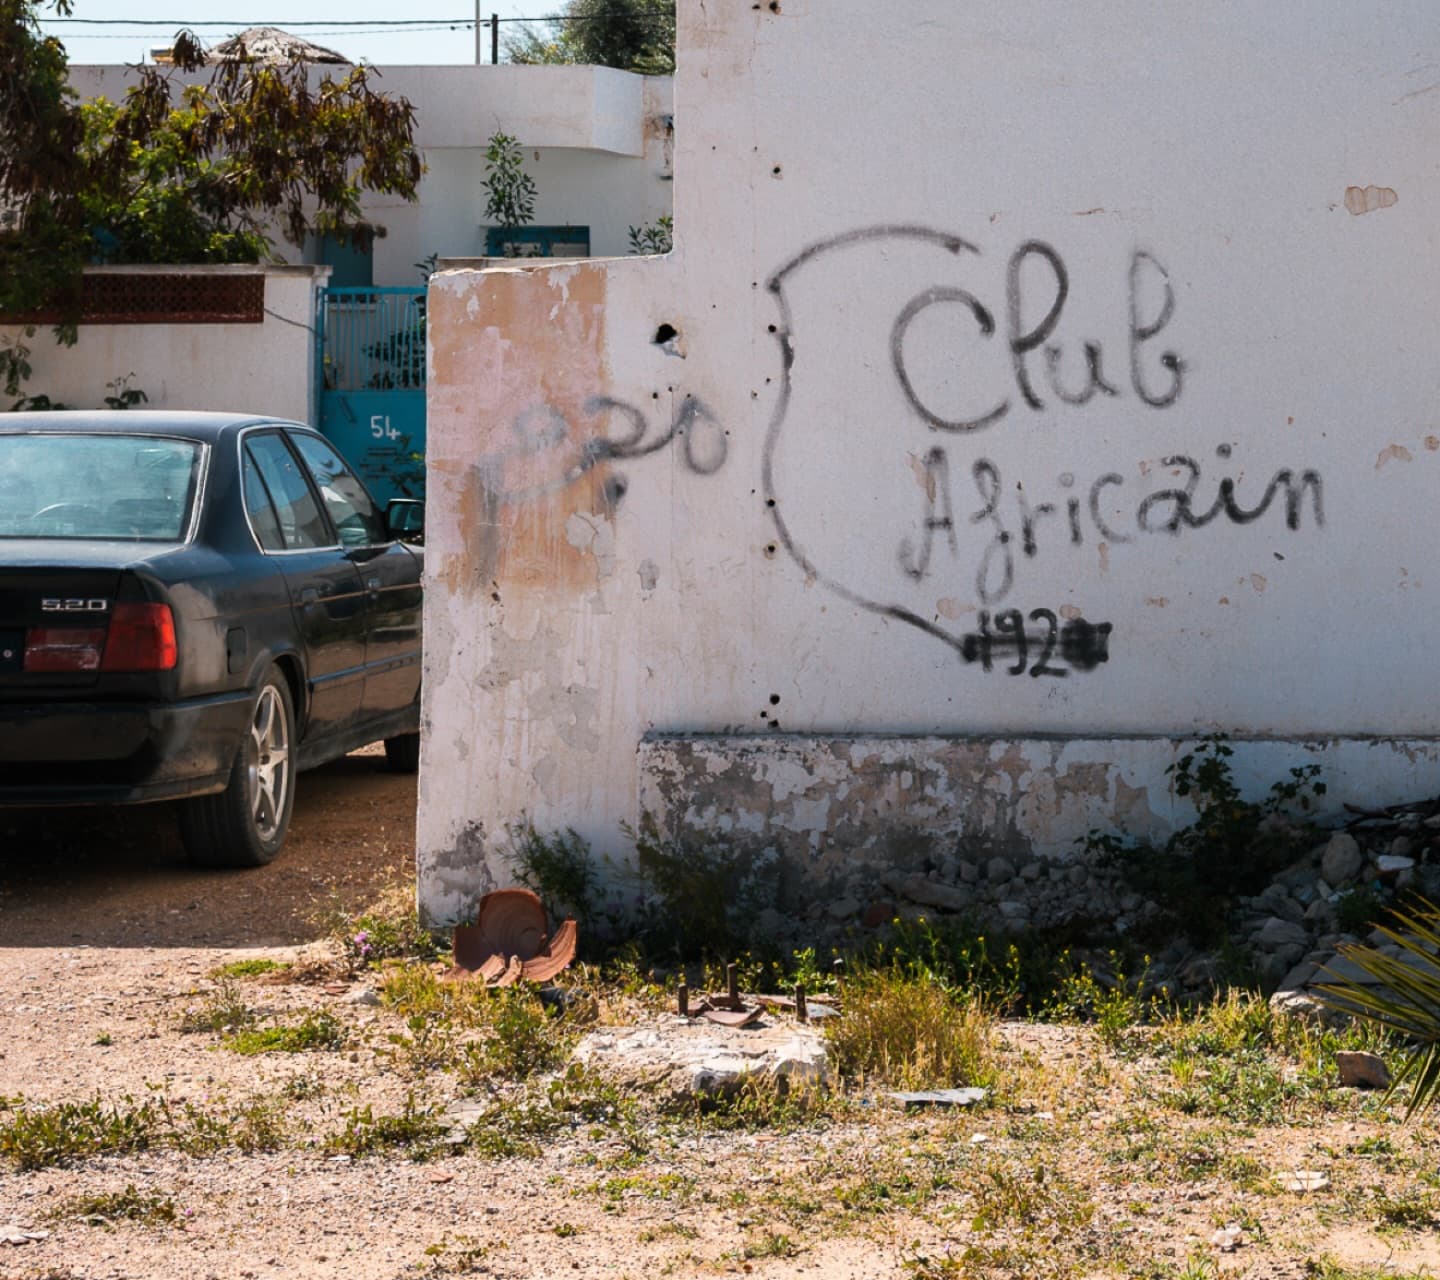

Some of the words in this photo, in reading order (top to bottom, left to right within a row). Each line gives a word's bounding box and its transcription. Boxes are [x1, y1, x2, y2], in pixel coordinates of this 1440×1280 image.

[890, 239, 1190, 432] Club
[370, 414, 402, 441] 54
[898, 442, 1326, 604] Africain
[41, 597, 108, 612] 520
